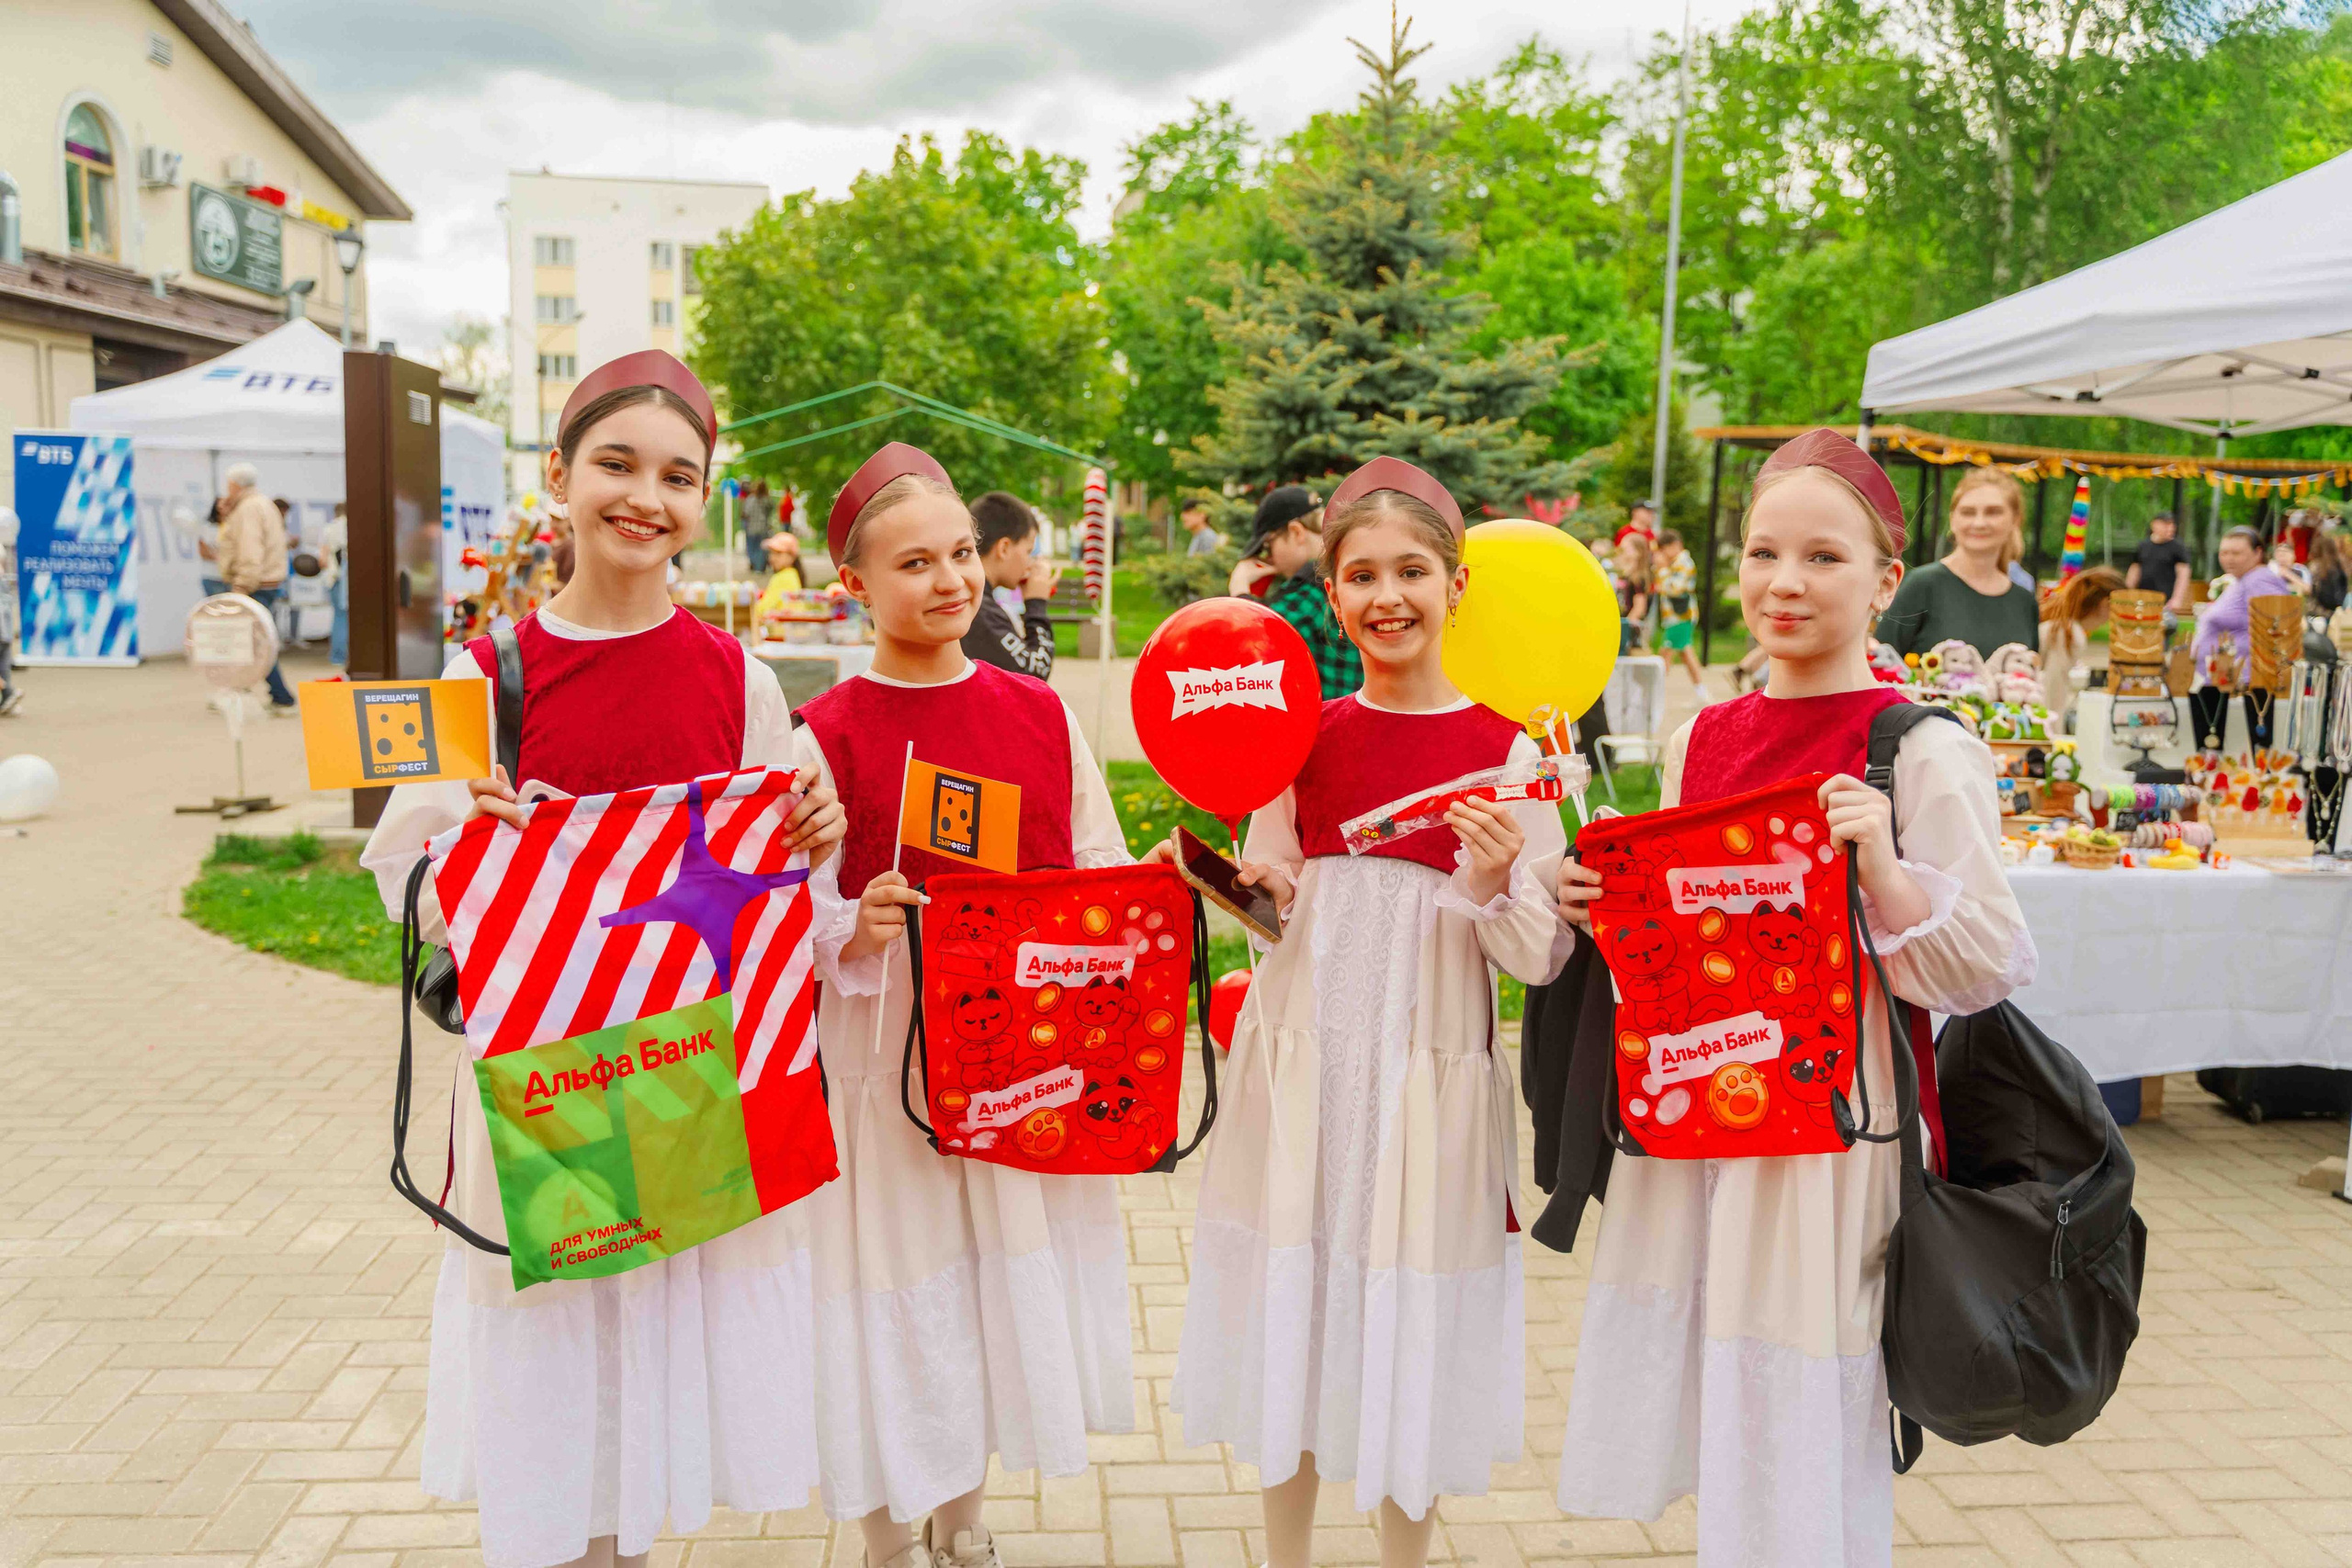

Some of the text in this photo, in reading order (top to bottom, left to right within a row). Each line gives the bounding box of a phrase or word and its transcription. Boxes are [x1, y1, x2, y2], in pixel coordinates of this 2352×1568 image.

[242, 371, 337, 393] ВТБ
[38, 445, 74, 465] ВТБ
[365, 694, 419, 702] ВЕРЕЩАГИН
[1182, 677, 1273, 697] Альфа Банк
[374, 762, 428, 773] СЫРФЕСТ
[941, 779, 974, 793] ВЕРЕЩАГИН
[936, 837, 970, 852] СЫРФЕСТ
[1681, 879, 1792, 901] Альфа Банк
[1027, 955, 1125, 977] Альфа Банк
[1661, 1028, 1770, 1068] Альфа Банк
[524, 1029, 716, 1106] Альфа Банк
[978, 1076, 1074, 1117] Альфа Банк
[549, 1216, 644, 1257] ДЛЯ УМНЫХ
[550, 1227, 662, 1270] И СВОБОДНЫХ
